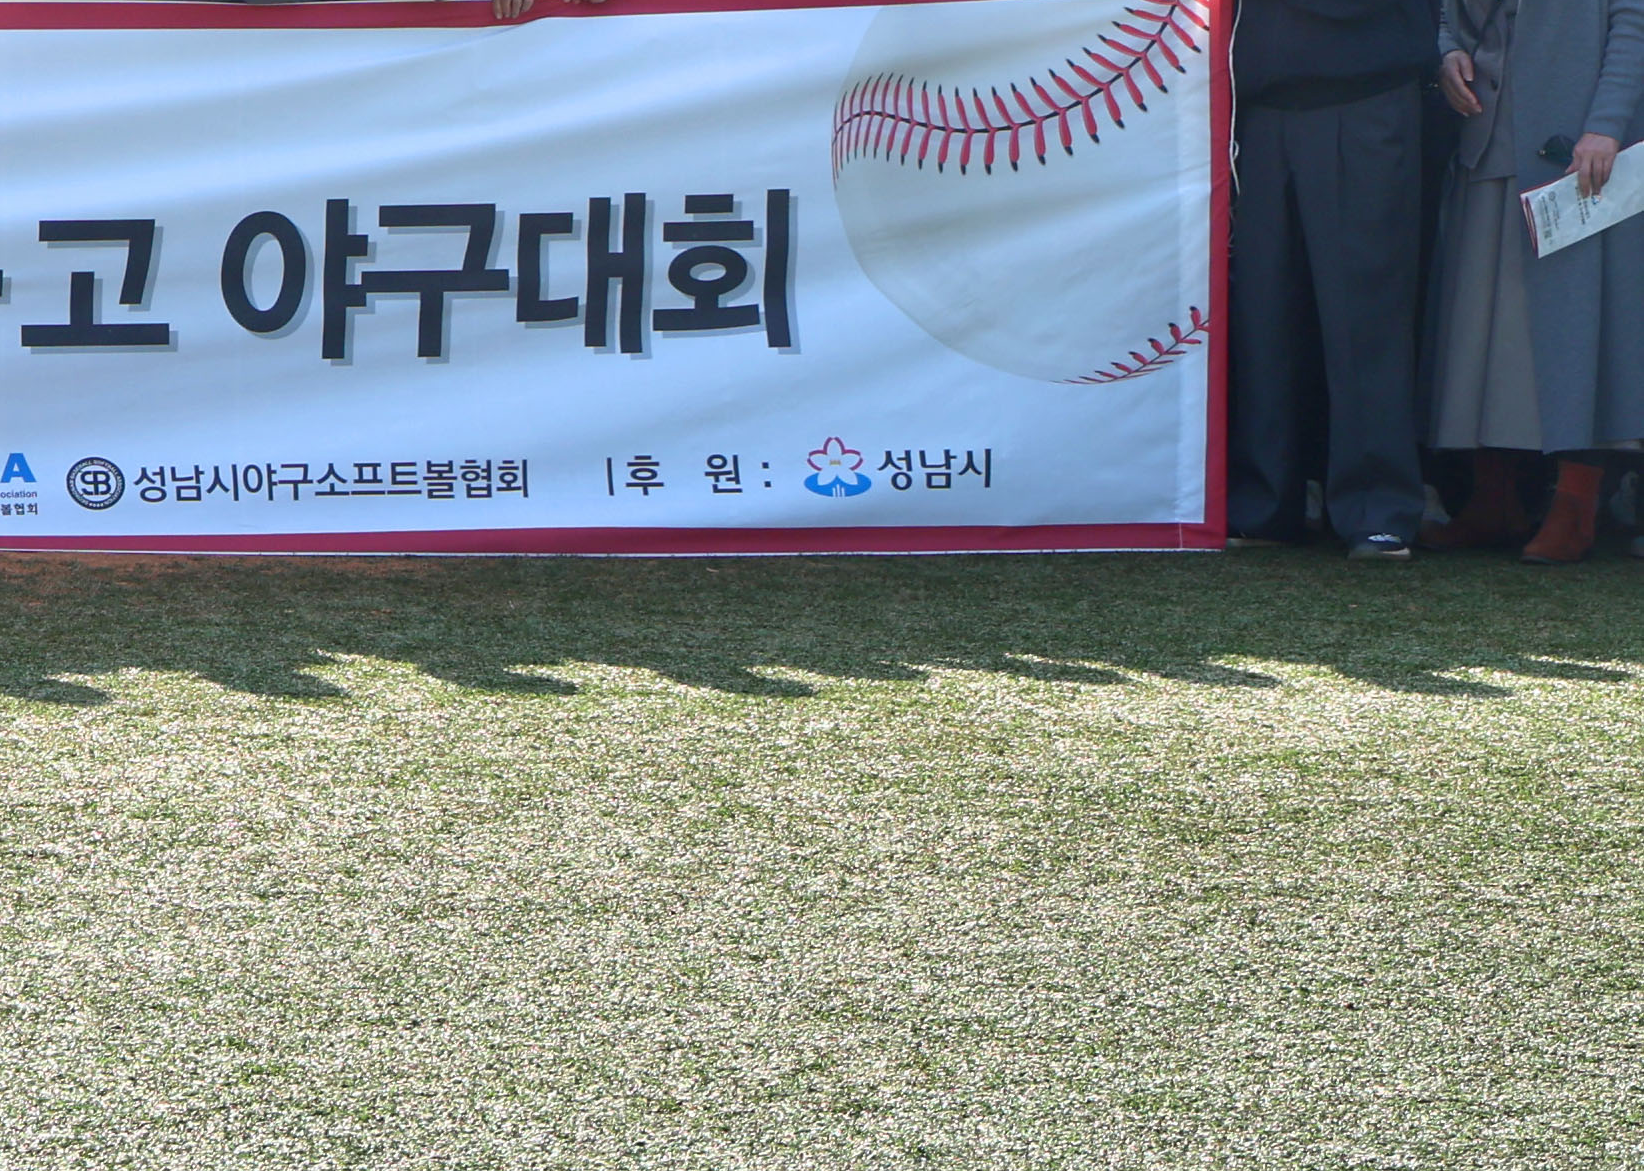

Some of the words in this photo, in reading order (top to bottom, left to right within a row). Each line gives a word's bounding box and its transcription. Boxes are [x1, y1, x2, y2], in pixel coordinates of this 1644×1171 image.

[220, 189, 795, 361] 야구대회
[134, 459, 529, 503] 성남시야구소프트볼협회
[625, 455, 665, 496] 후
[704, 454, 743, 494] 원
[878, 448, 992, 491] 성남시
